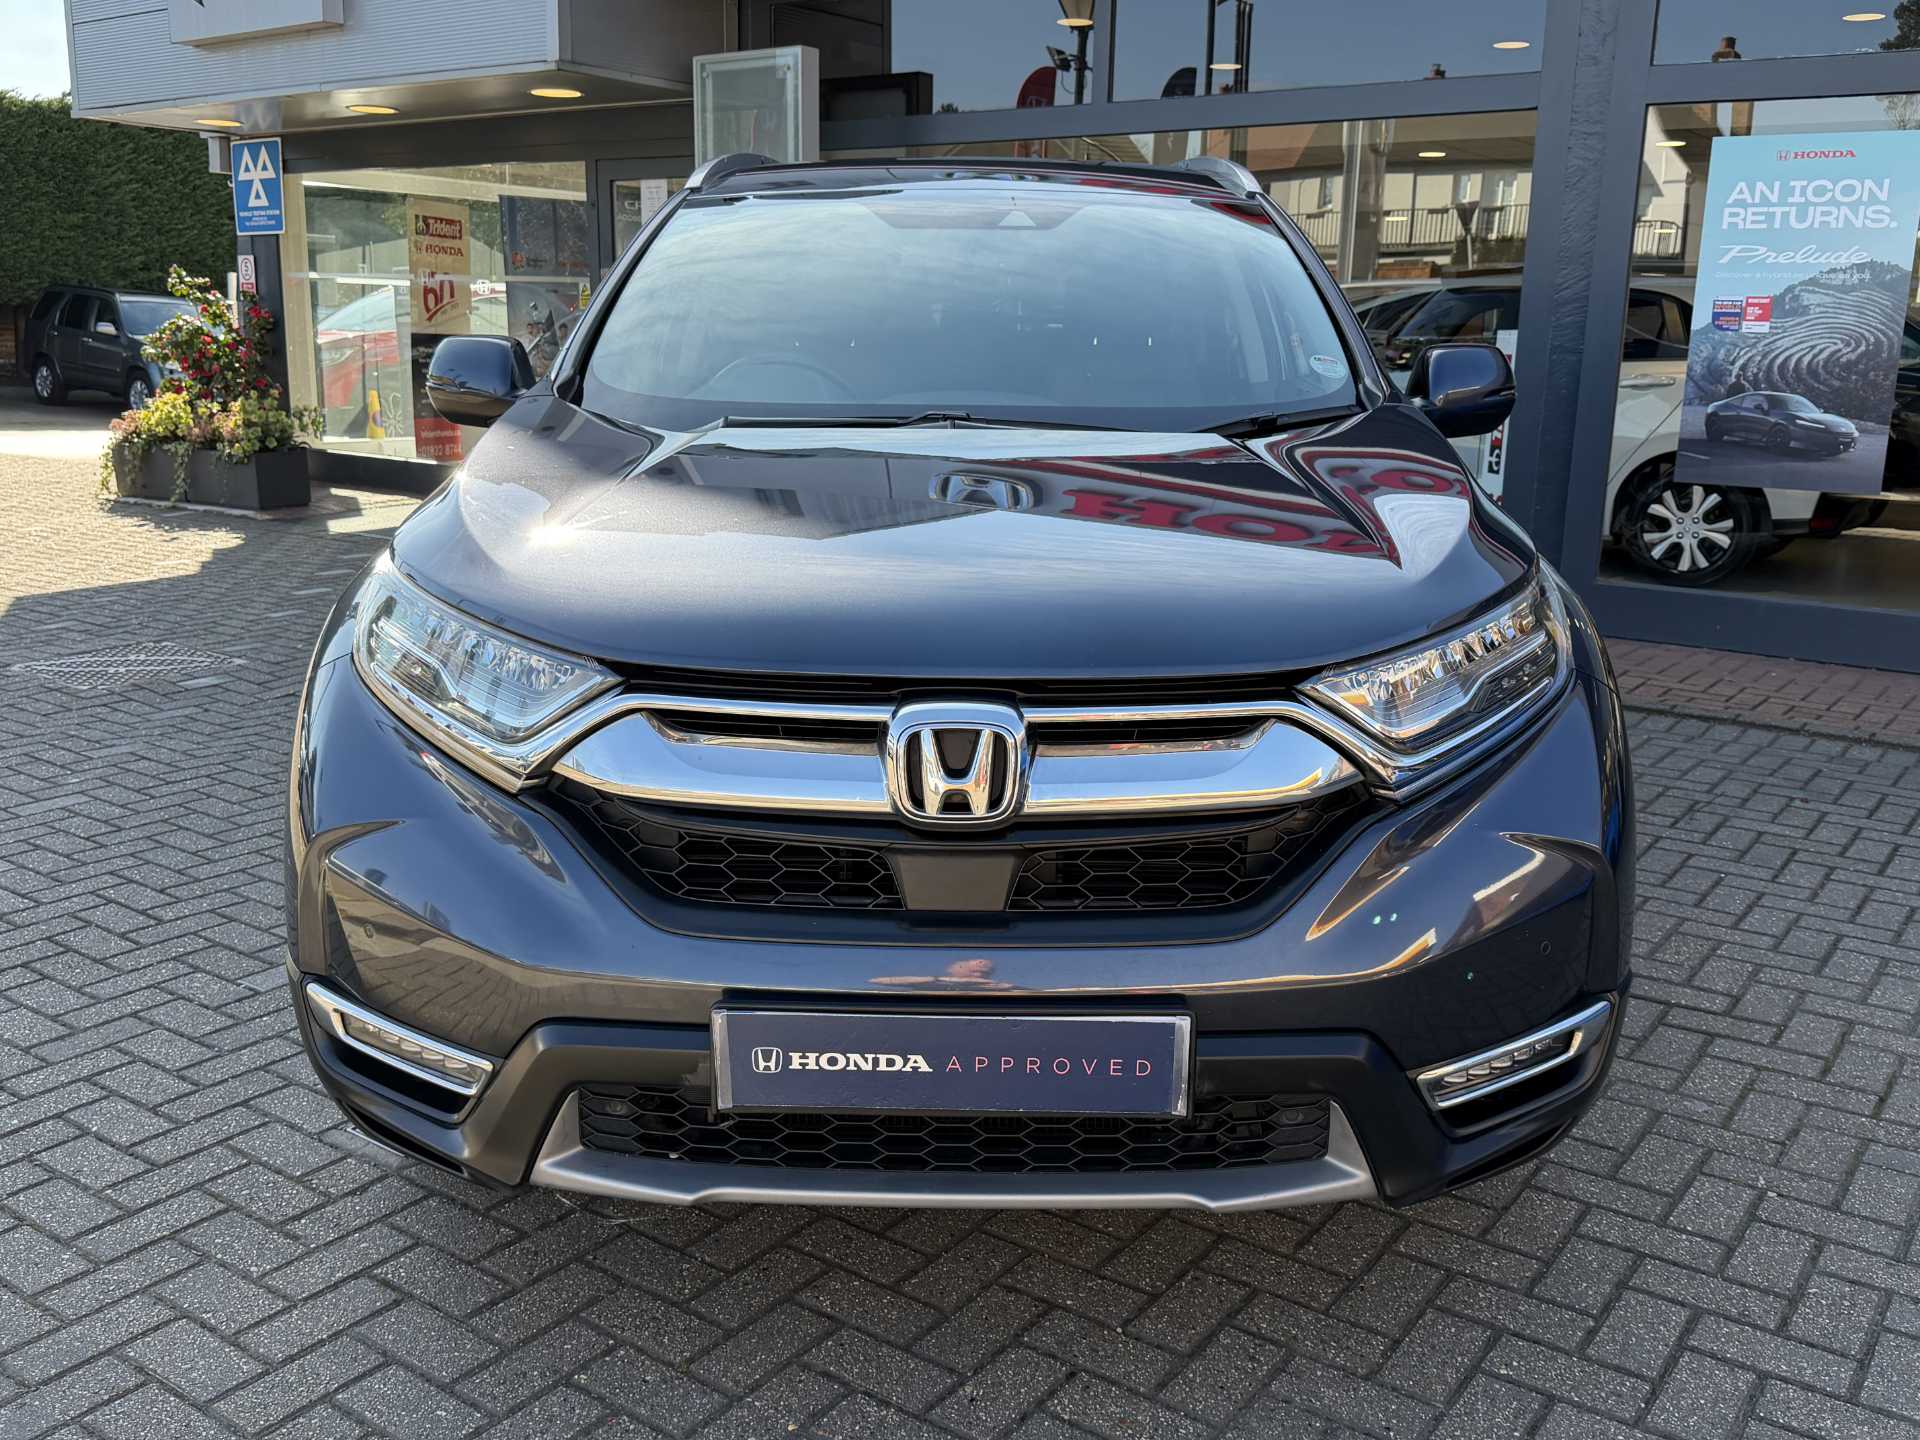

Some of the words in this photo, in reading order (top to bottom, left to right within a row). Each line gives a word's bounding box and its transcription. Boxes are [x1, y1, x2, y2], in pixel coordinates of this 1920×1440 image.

[1793, 150, 1856, 160] HONDA
[1726, 181, 1781, 204] AN
[1787, 178, 1890, 204] ICON
[427, 218, 461, 237] Trident
[1721, 205, 1899, 230] RETURNS.
[425, 244, 464, 257] HONDA
[1717, 244, 1871, 264] Prelude
[788, 1051, 934, 1074] HONDA
[945, 1055, 1153, 1077] APPROVED
